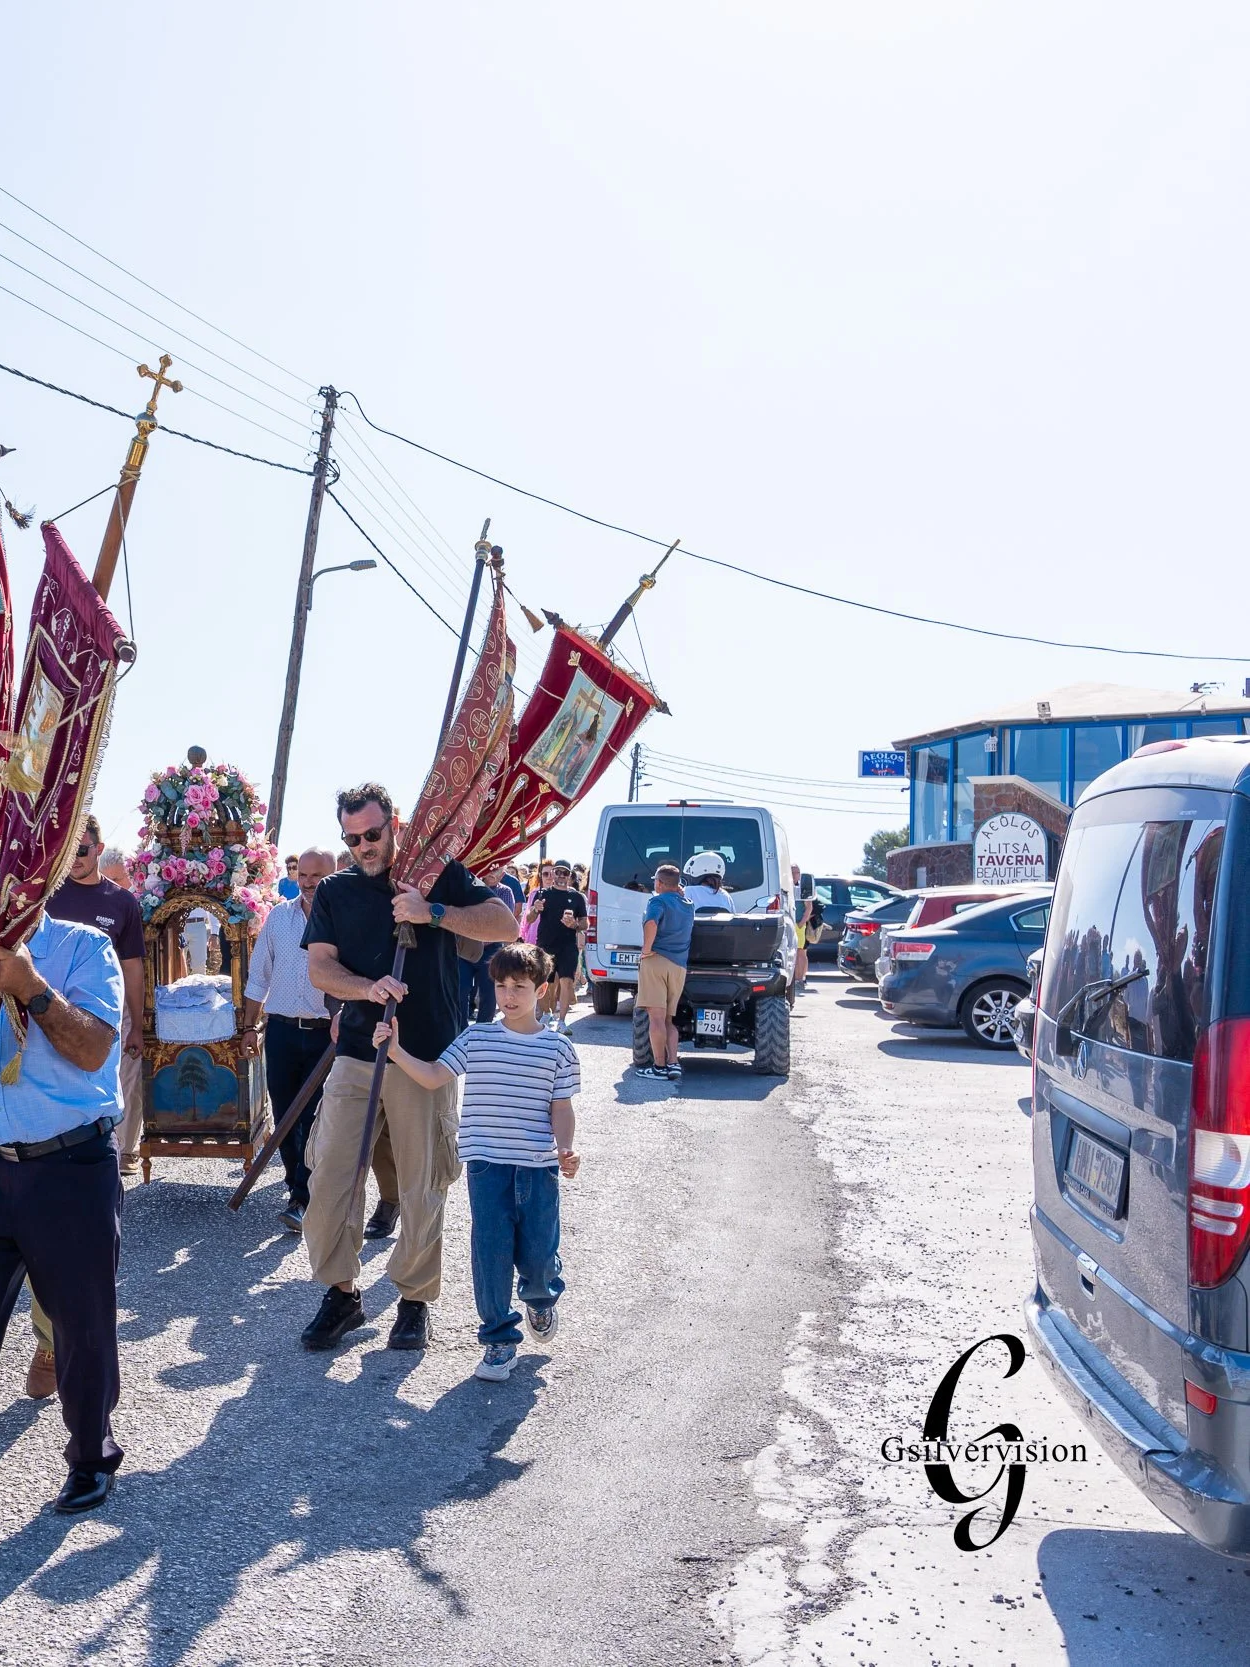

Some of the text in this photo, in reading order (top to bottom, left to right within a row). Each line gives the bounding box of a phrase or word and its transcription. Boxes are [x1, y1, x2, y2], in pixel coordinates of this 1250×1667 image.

[863, 752, 905, 763] AEOLOS
[976, 866, 1041, 878] BEAUTIFUL
[703, 1023, 723, 1034] 794
